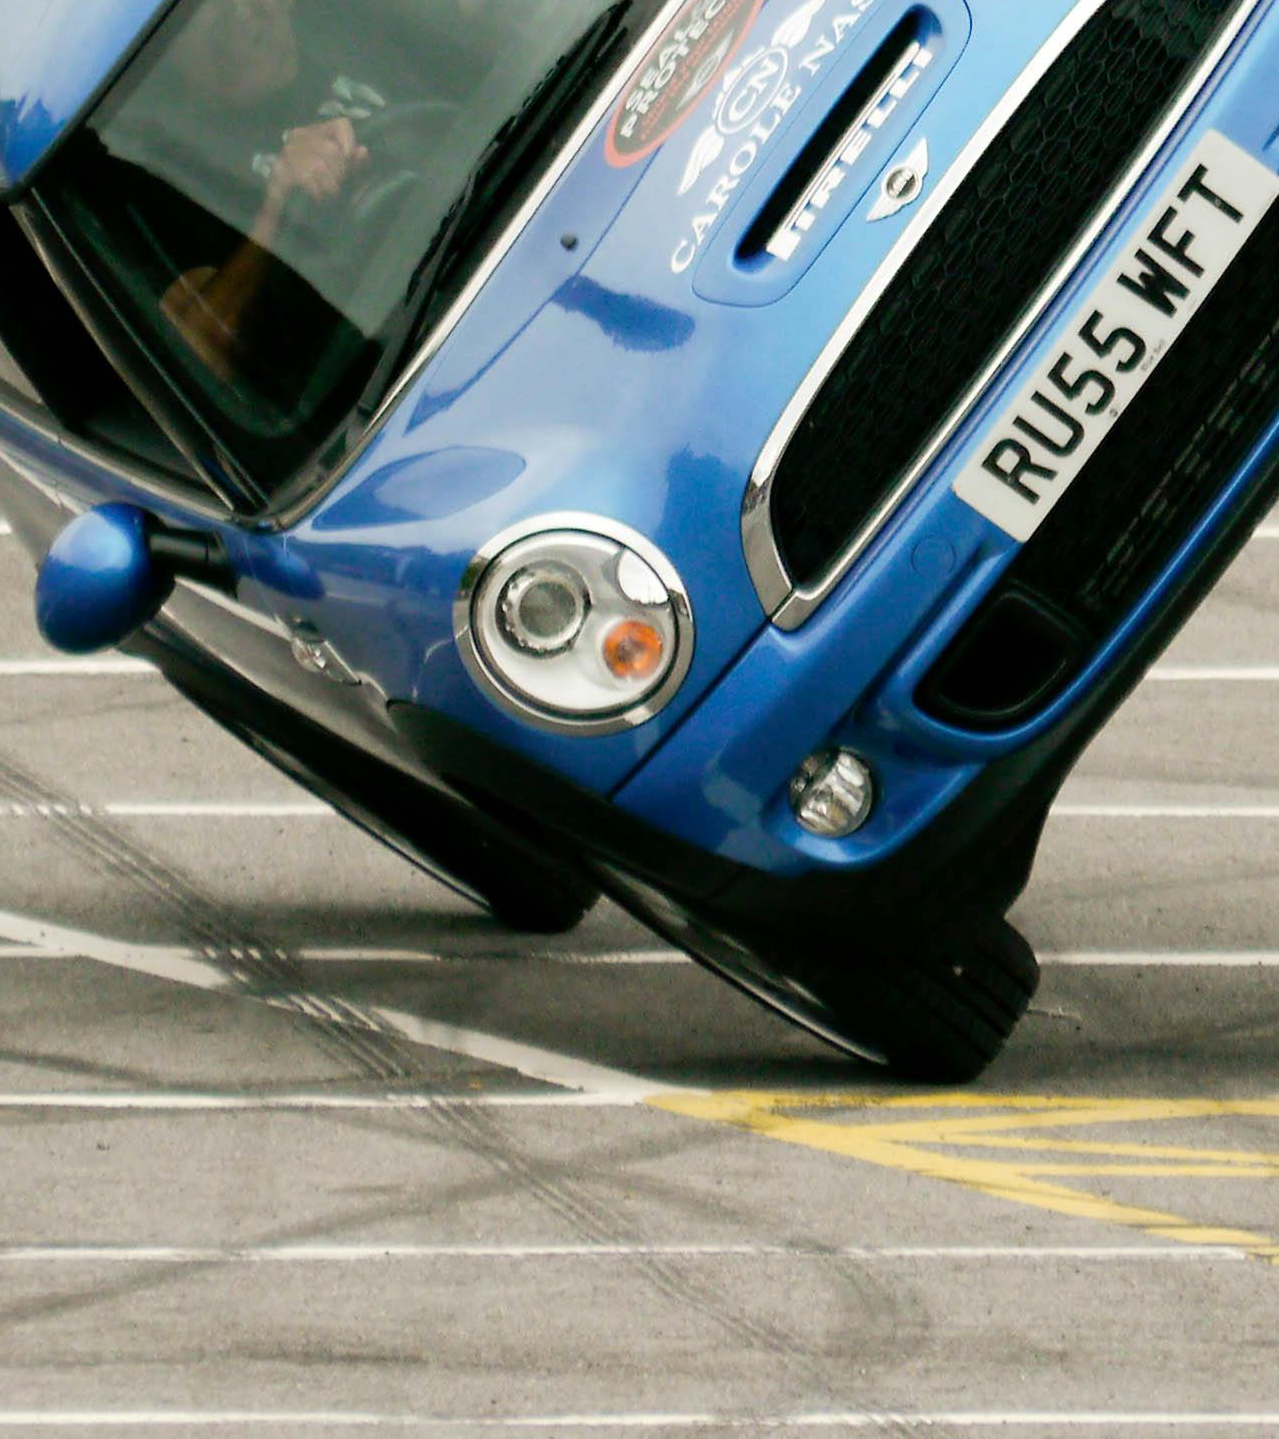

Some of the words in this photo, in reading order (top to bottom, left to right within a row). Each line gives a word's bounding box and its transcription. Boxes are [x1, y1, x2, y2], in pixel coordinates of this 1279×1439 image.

[623, 28, 690, 112] SEAL
[727, 59, 779, 122] CN
[765, 42, 933, 262] PIRELLI
[671, 84, 802, 274] CAROLE
[980, 308, 1148, 506] RU55
[1116, 163, 1244, 319] WFT
